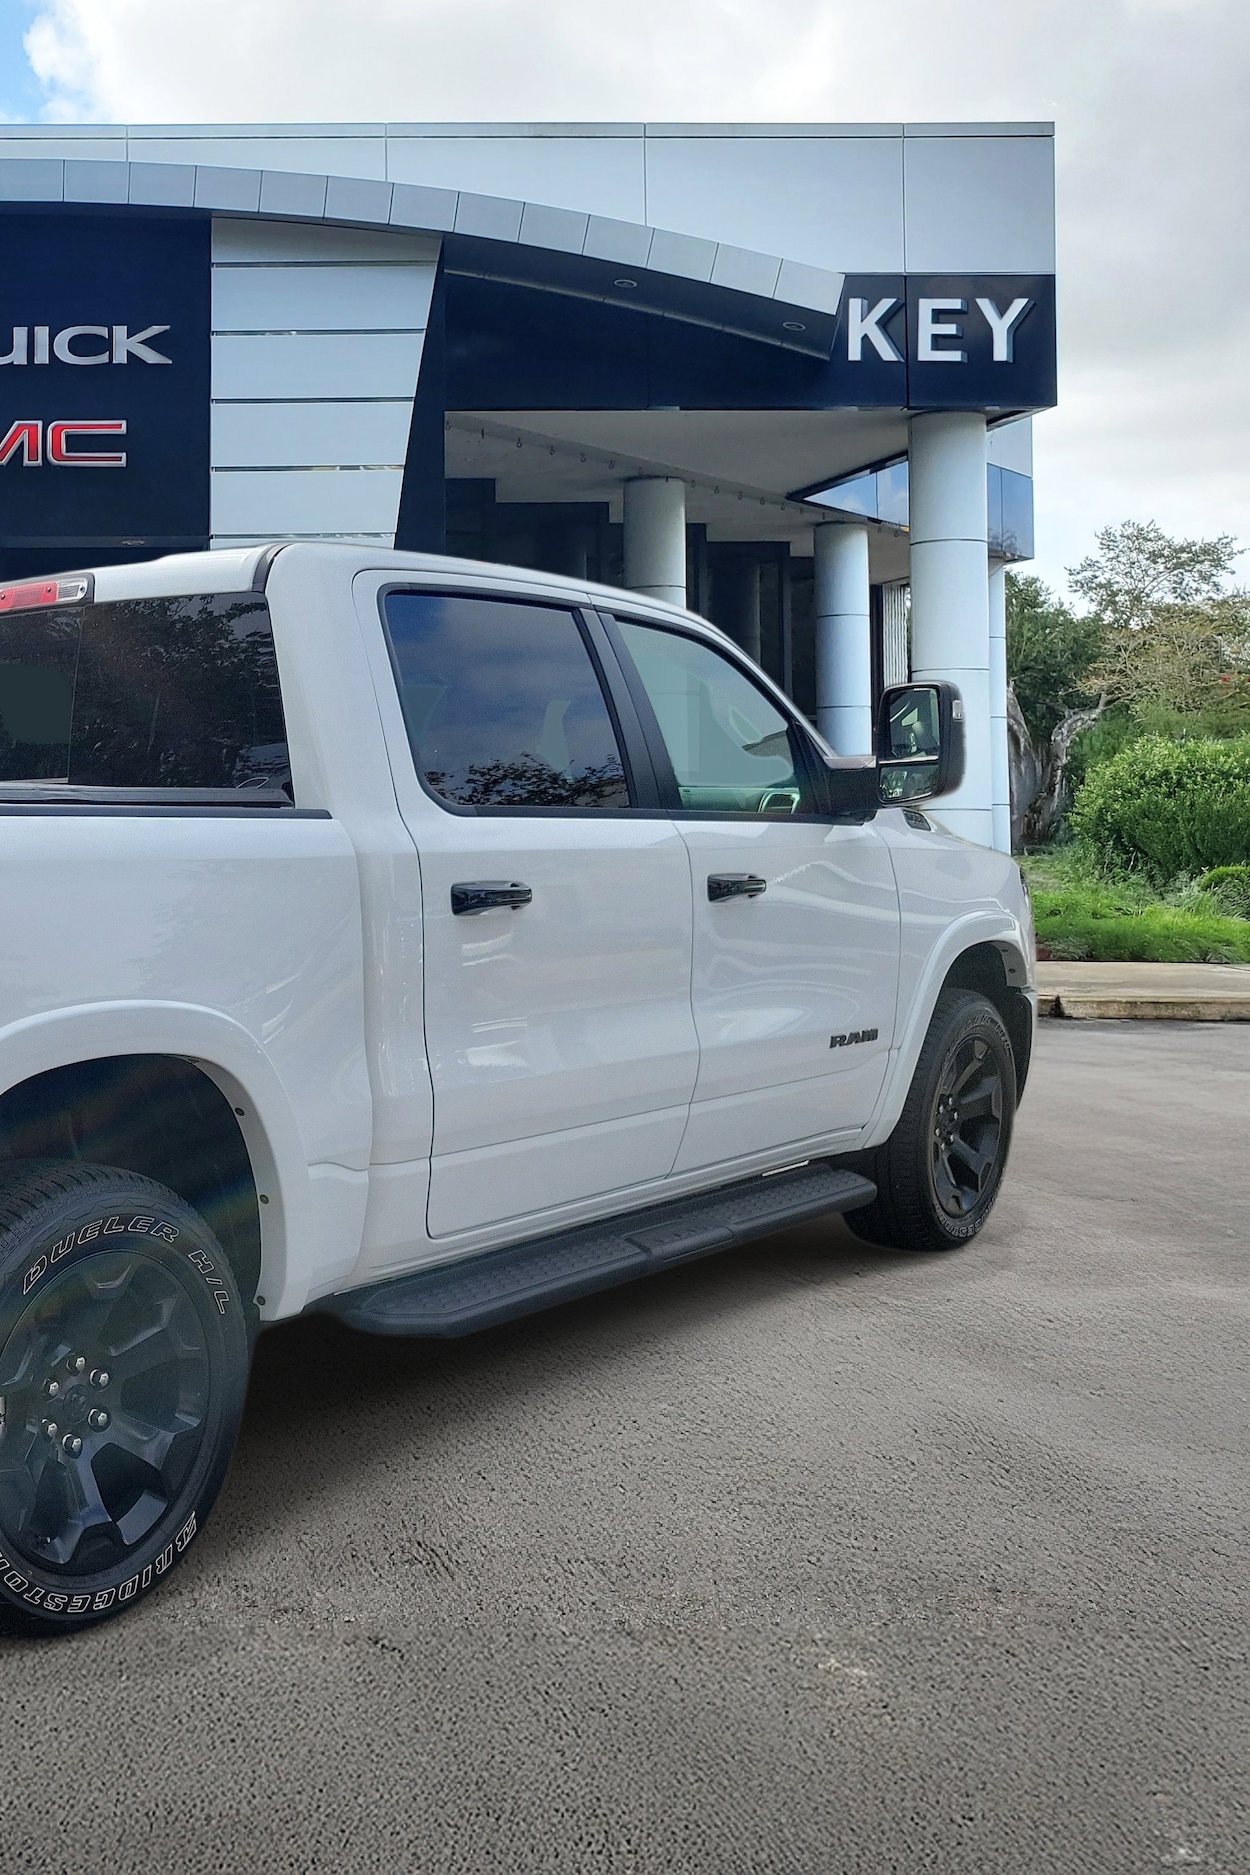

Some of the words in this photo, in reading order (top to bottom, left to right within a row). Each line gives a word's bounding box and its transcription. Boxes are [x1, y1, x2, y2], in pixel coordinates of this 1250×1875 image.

[847, 297, 1036, 363] KEY
[829, 1028, 879, 1049] RAM
[22, 1215, 180, 1296] DUELER
[187, 1249, 231, 1315] H/L
